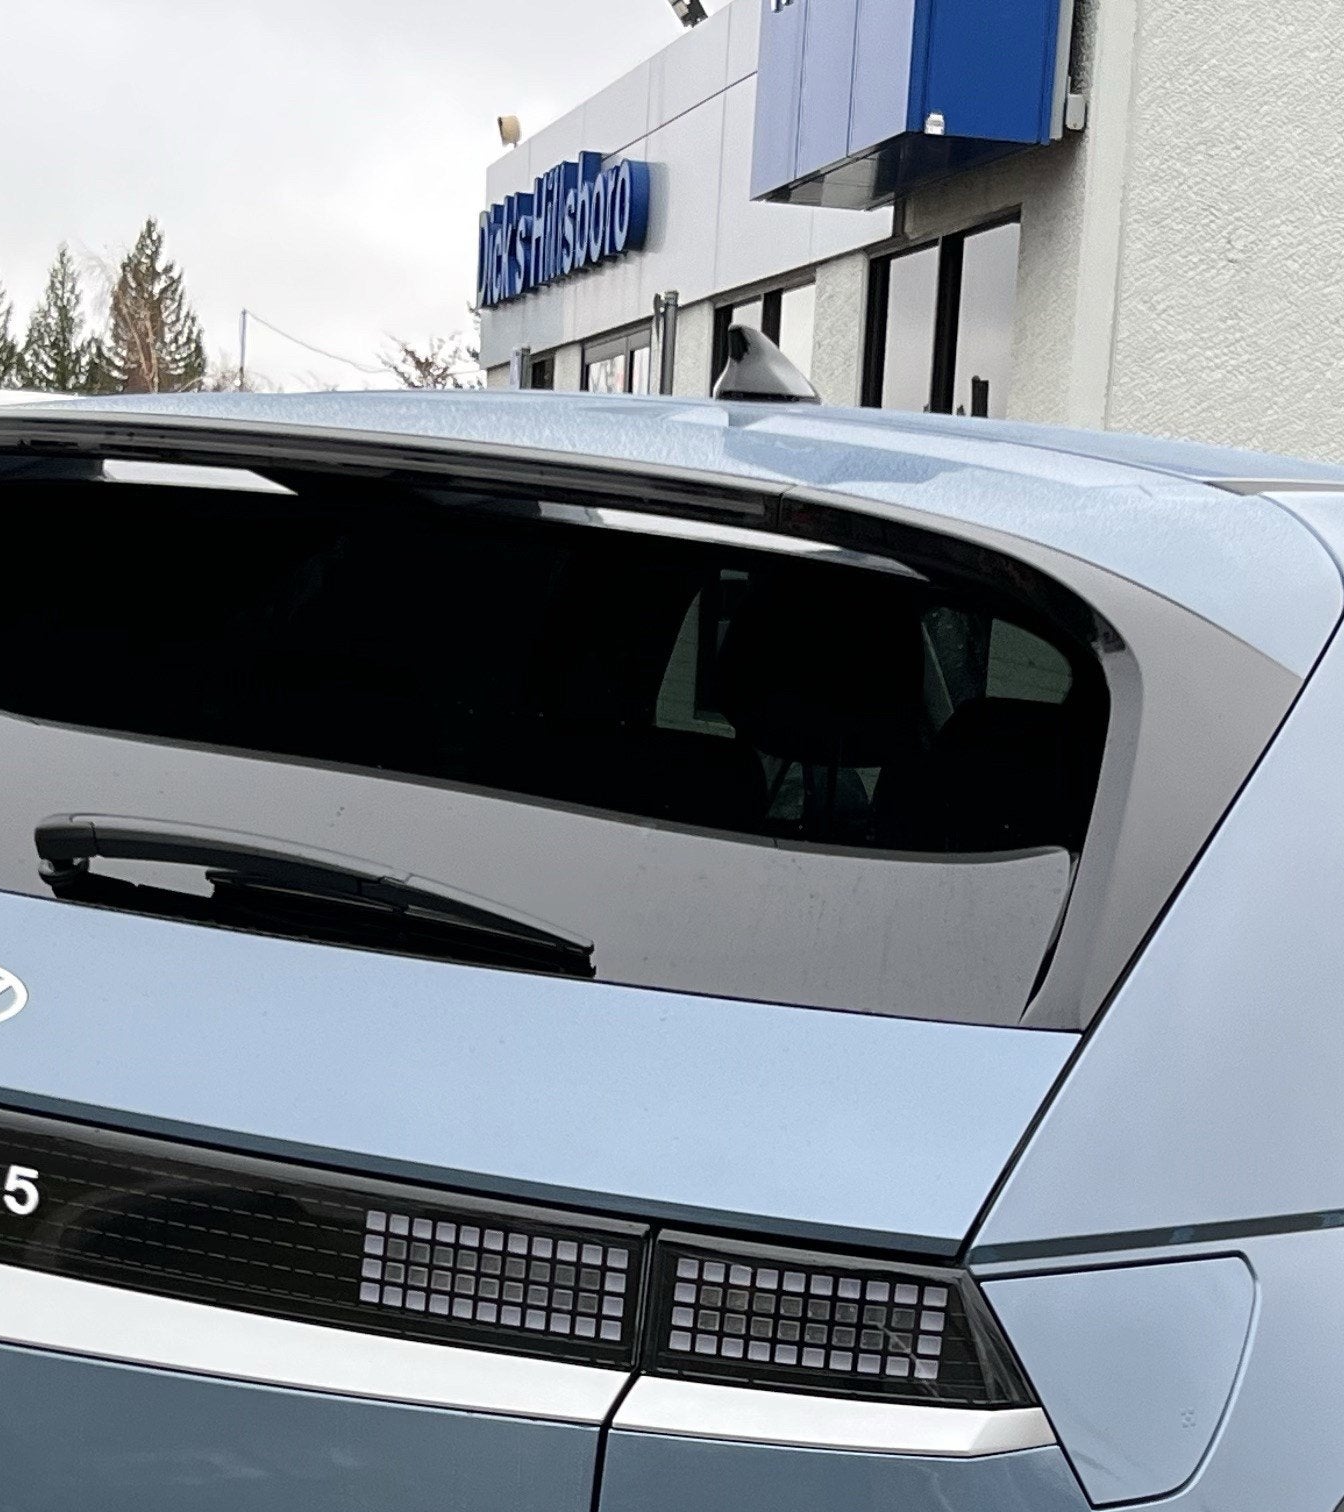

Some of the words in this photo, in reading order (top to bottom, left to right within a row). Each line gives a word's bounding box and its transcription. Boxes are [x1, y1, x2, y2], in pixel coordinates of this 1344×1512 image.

[477, 193, 527, 308] Dick's
[529, 151, 630, 285] Hillsboro
[2, 1164, 40, 1216] 5
